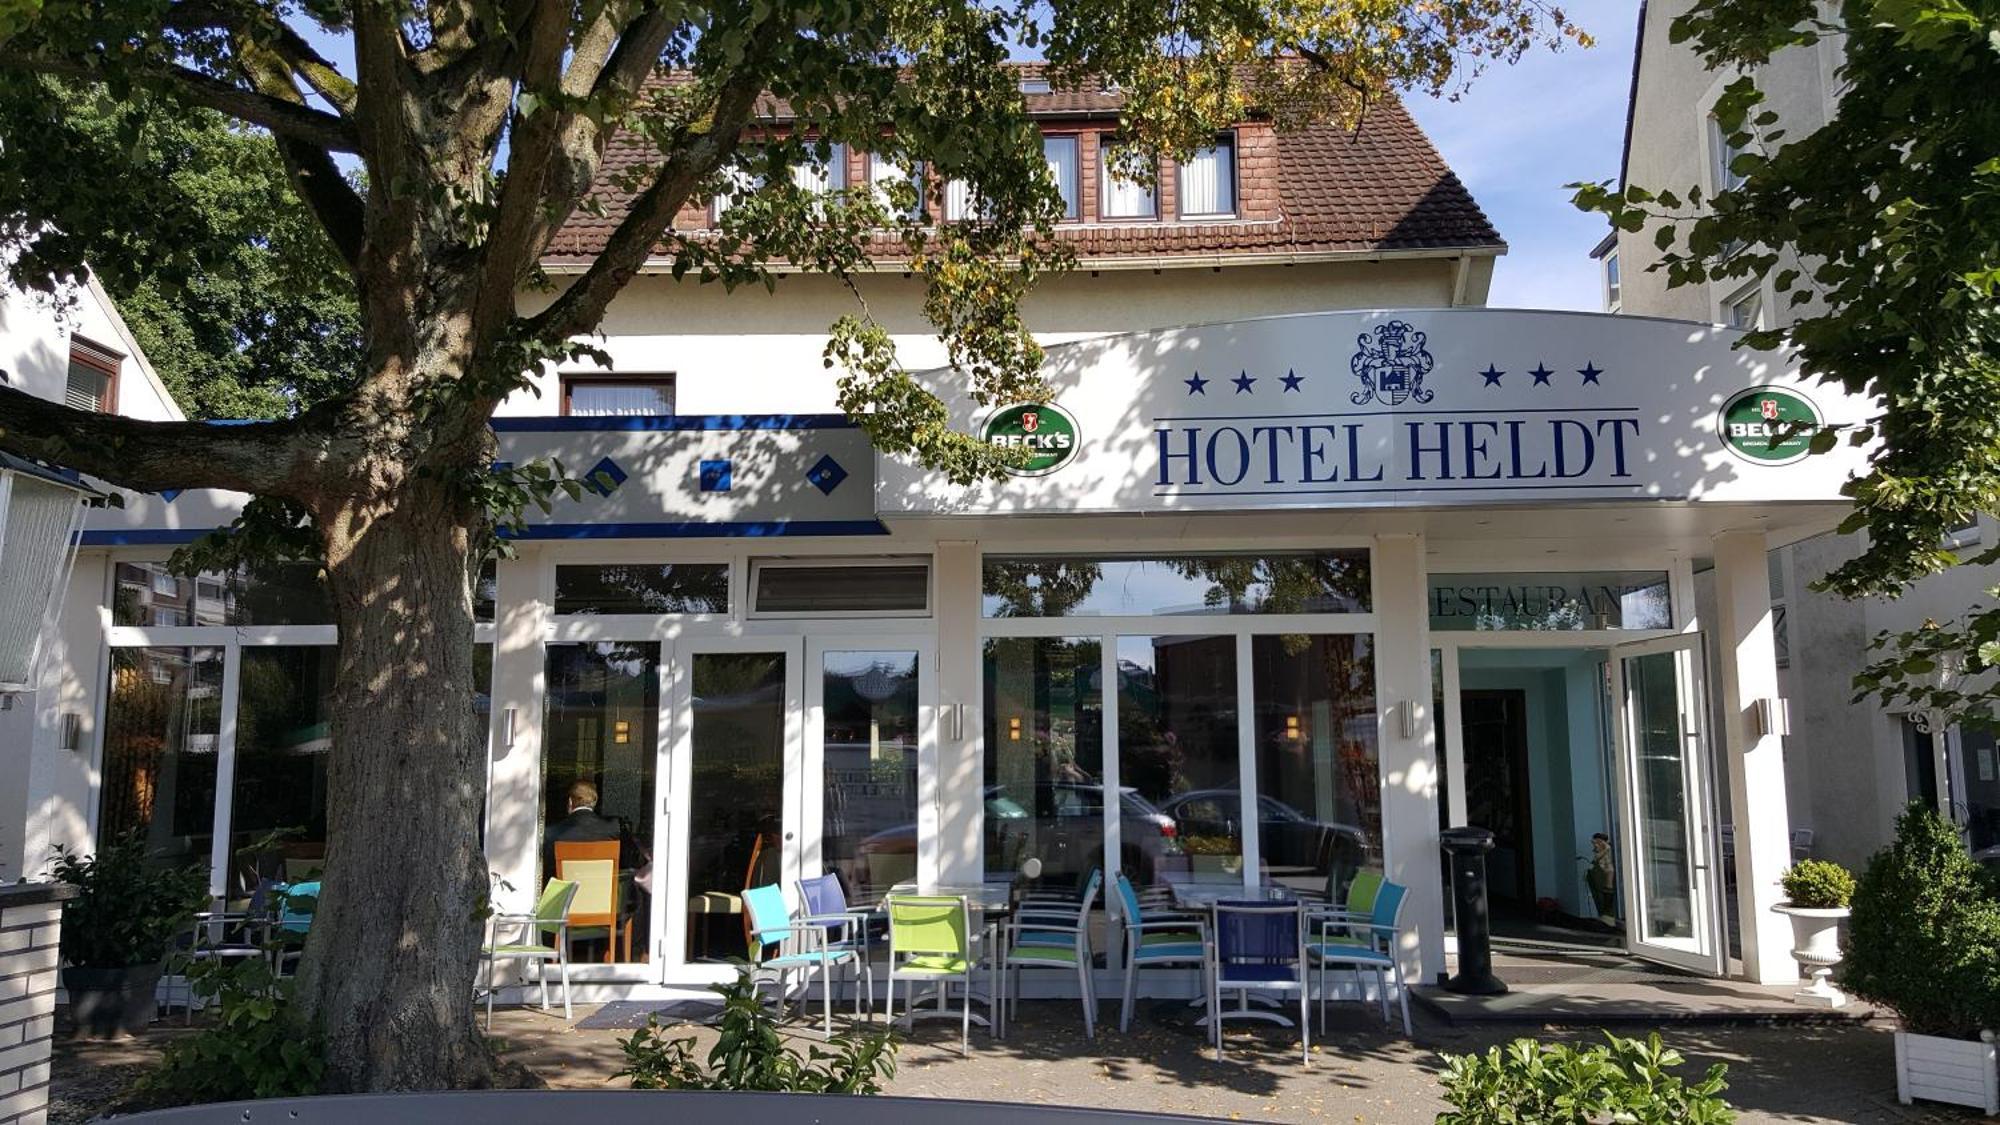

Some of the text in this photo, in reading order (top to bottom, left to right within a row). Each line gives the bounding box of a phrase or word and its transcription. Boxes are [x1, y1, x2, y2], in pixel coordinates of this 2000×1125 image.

[991, 431, 1070, 449] BECK'S
[1729, 422, 1814, 438] BECK
[1153, 418, 1640, 486] HOTEL HELDT
[1430, 584, 1648, 618] ESTAURAN
